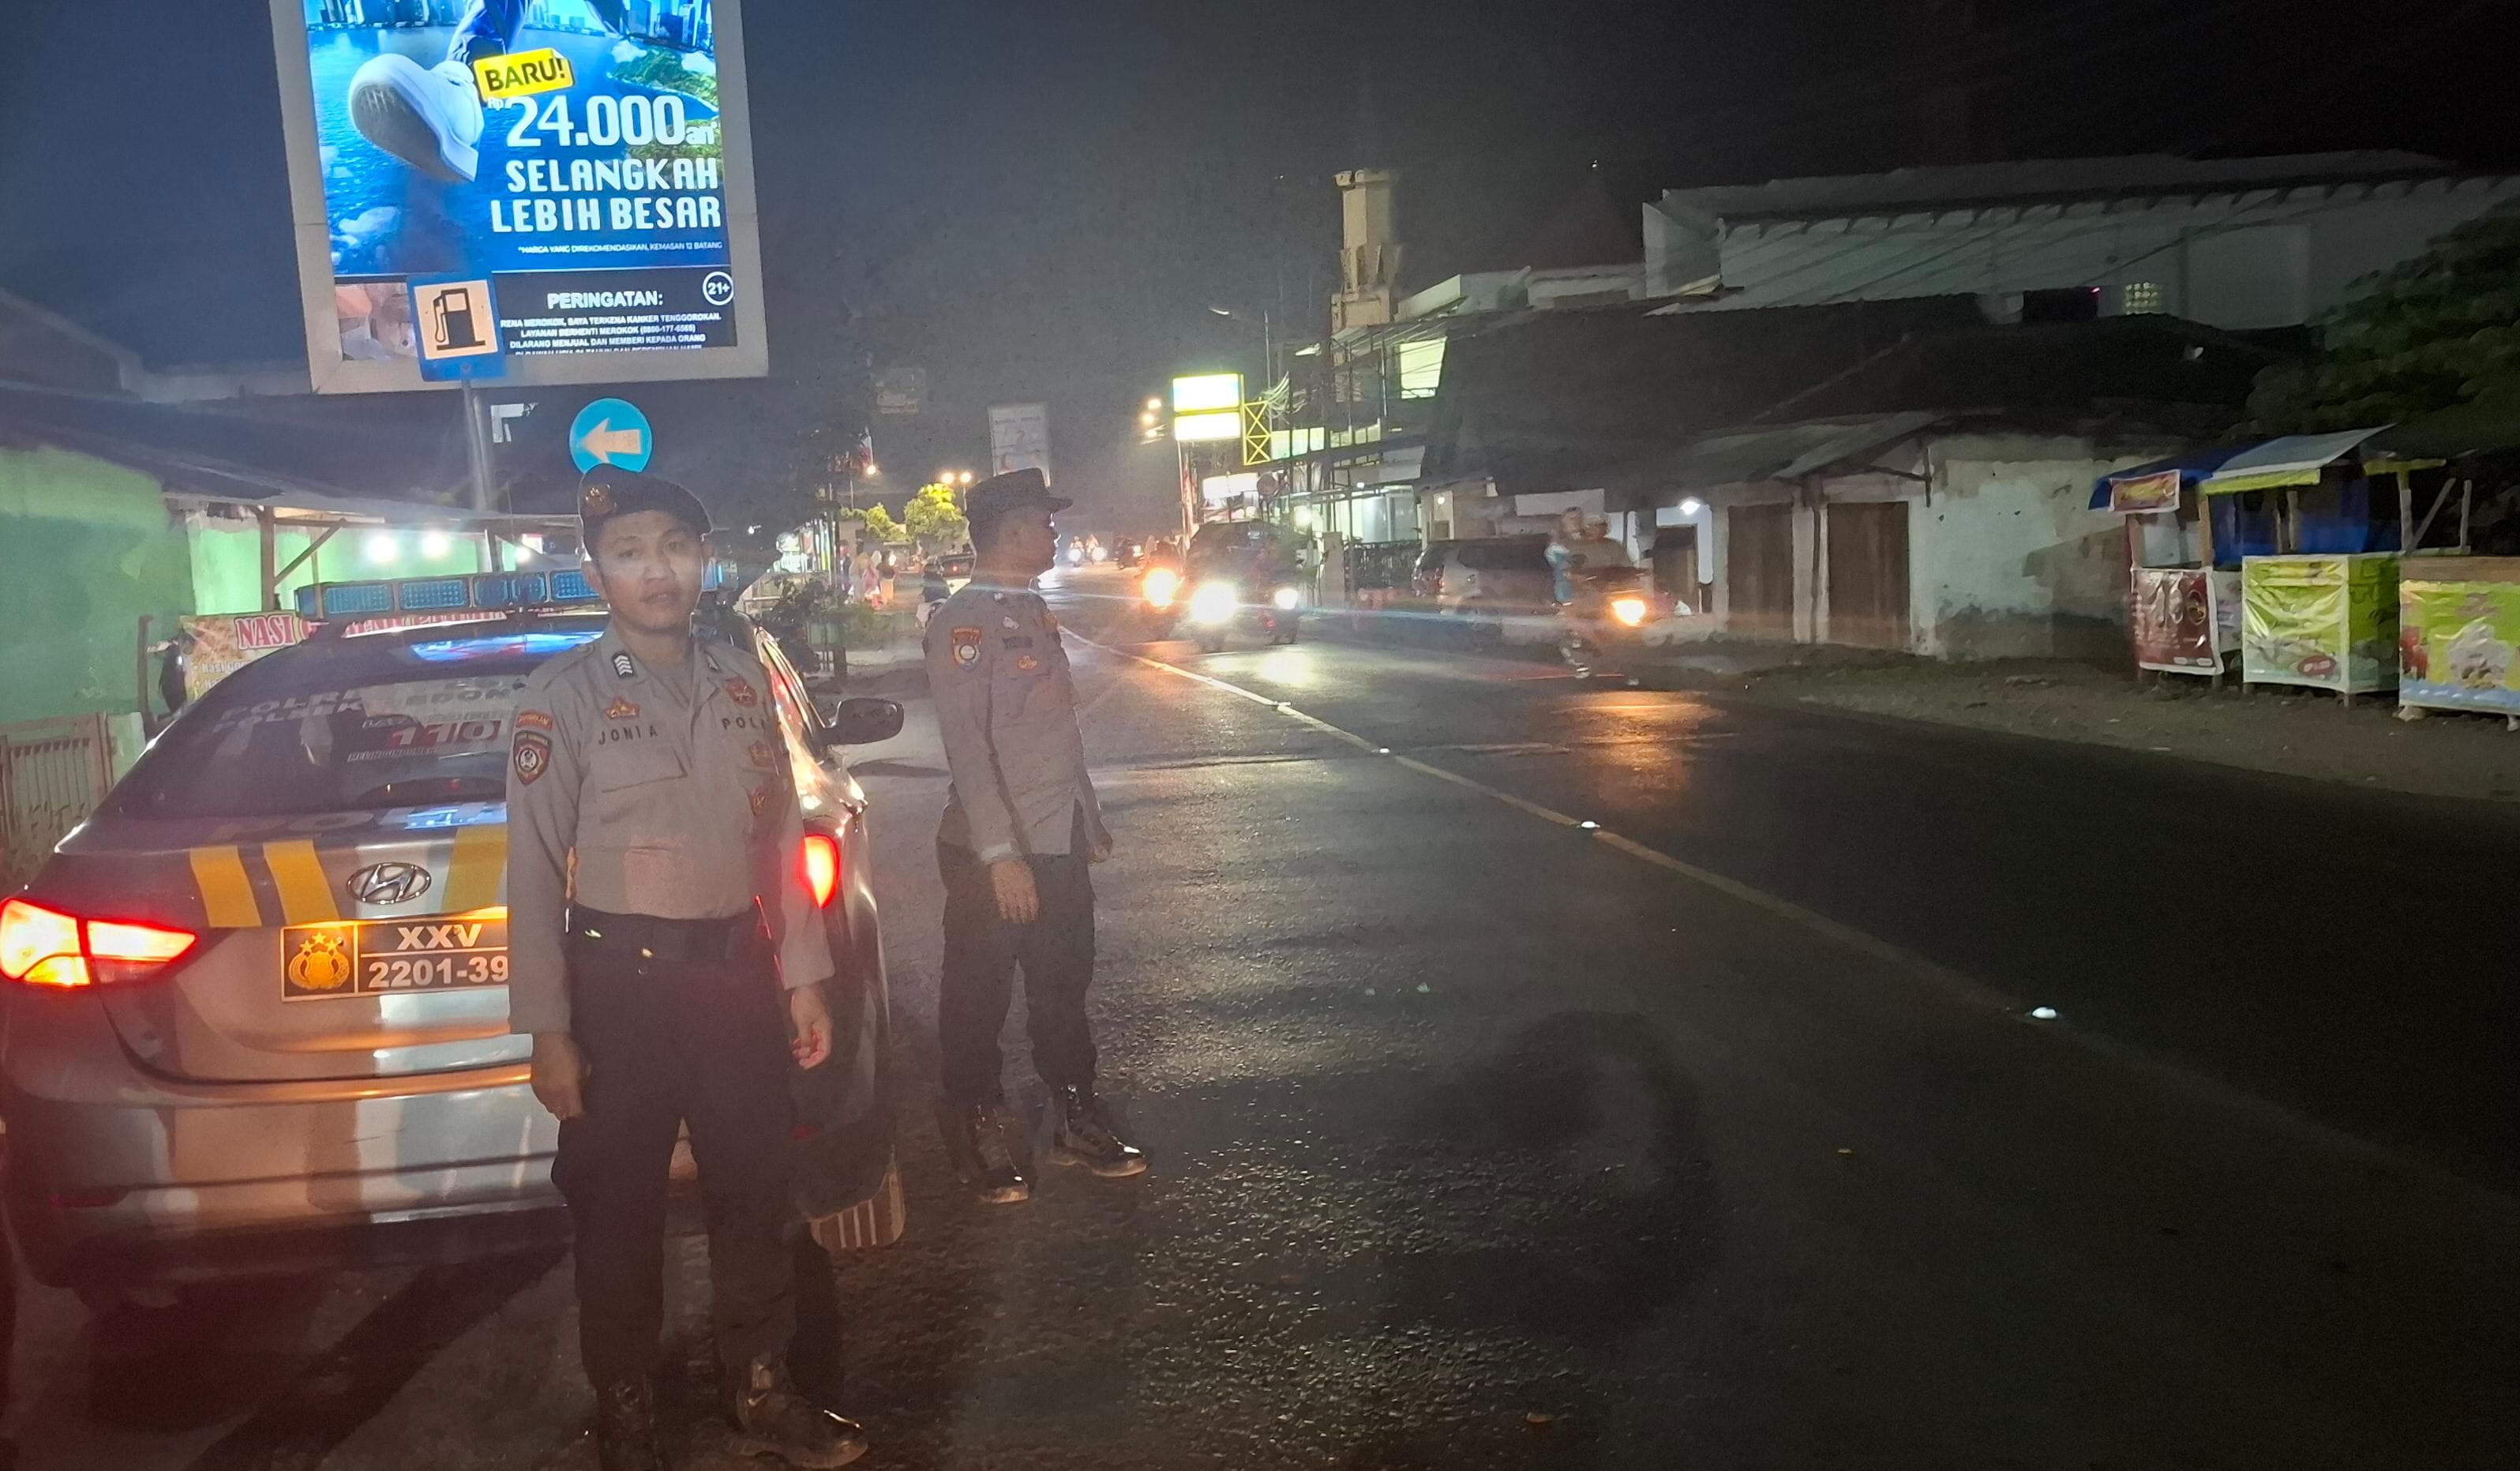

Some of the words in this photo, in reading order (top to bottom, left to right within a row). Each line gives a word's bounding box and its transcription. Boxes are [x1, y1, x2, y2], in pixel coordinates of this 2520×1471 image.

[484, 58, 566, 92] BARU!
[505, 158, 718, 193] SELANGKAH
[490, 198, 601, 233] LEBIH
[609, 196, 722, 231] BESAR
[694, 241, 722, 250] BATANG
[547, 291, 663, 310] PERINGATAN:
[707, 282, 730, 295] 21+
[500, 319, 523, 328] RENA
[588, 315, 626, 325] TERKENA
[627, 314, 659, 324] KANKER
[521, 328, 557, 338] LAYANAN
[599, 326, 639, 336] MEROKOK
[509, 340, 551, 349] DILARANG
[552, 339, 589, 347] MENJUAL
[609, 336, 644, 345] MEMBERI
[646, 335, 677, 343] KEPADA
[677, 334, 706, 343] ORANG
[236, 615, 297, 650] NASI
[392, 720, 491, 745] 110
[396, 923, 483, 951] XXV
[369, 955, 508, 988] 2201-39
